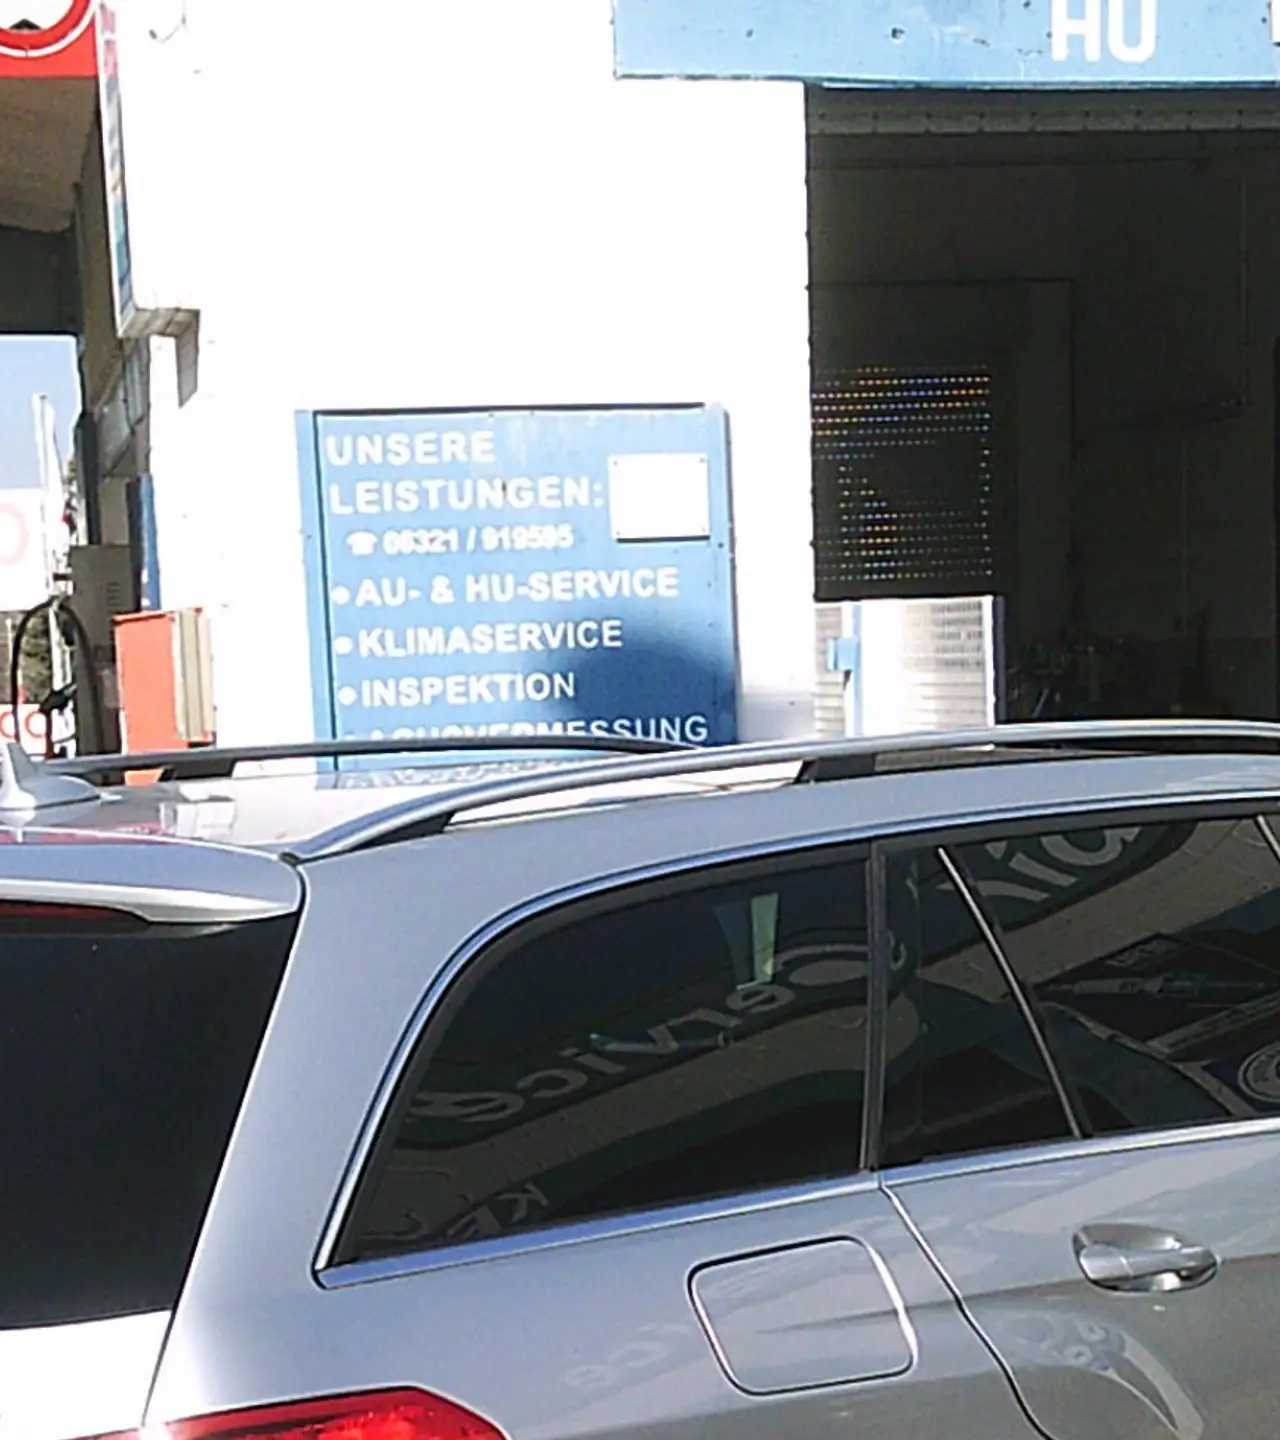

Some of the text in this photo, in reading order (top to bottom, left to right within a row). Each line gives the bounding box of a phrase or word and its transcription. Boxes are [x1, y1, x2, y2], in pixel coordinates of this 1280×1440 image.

[1051, 0, 1157, 63] HU
[324, 430, 496, 466] UNSERE
[329, 475, 605, 515] LEISTUNGEN:
[356, 567, 680, 607] AU- & HU-SERVICE
[359, 619, 624, 658] KLIMASERVICE
[362, 672, 576, 707] INSPEKTION
